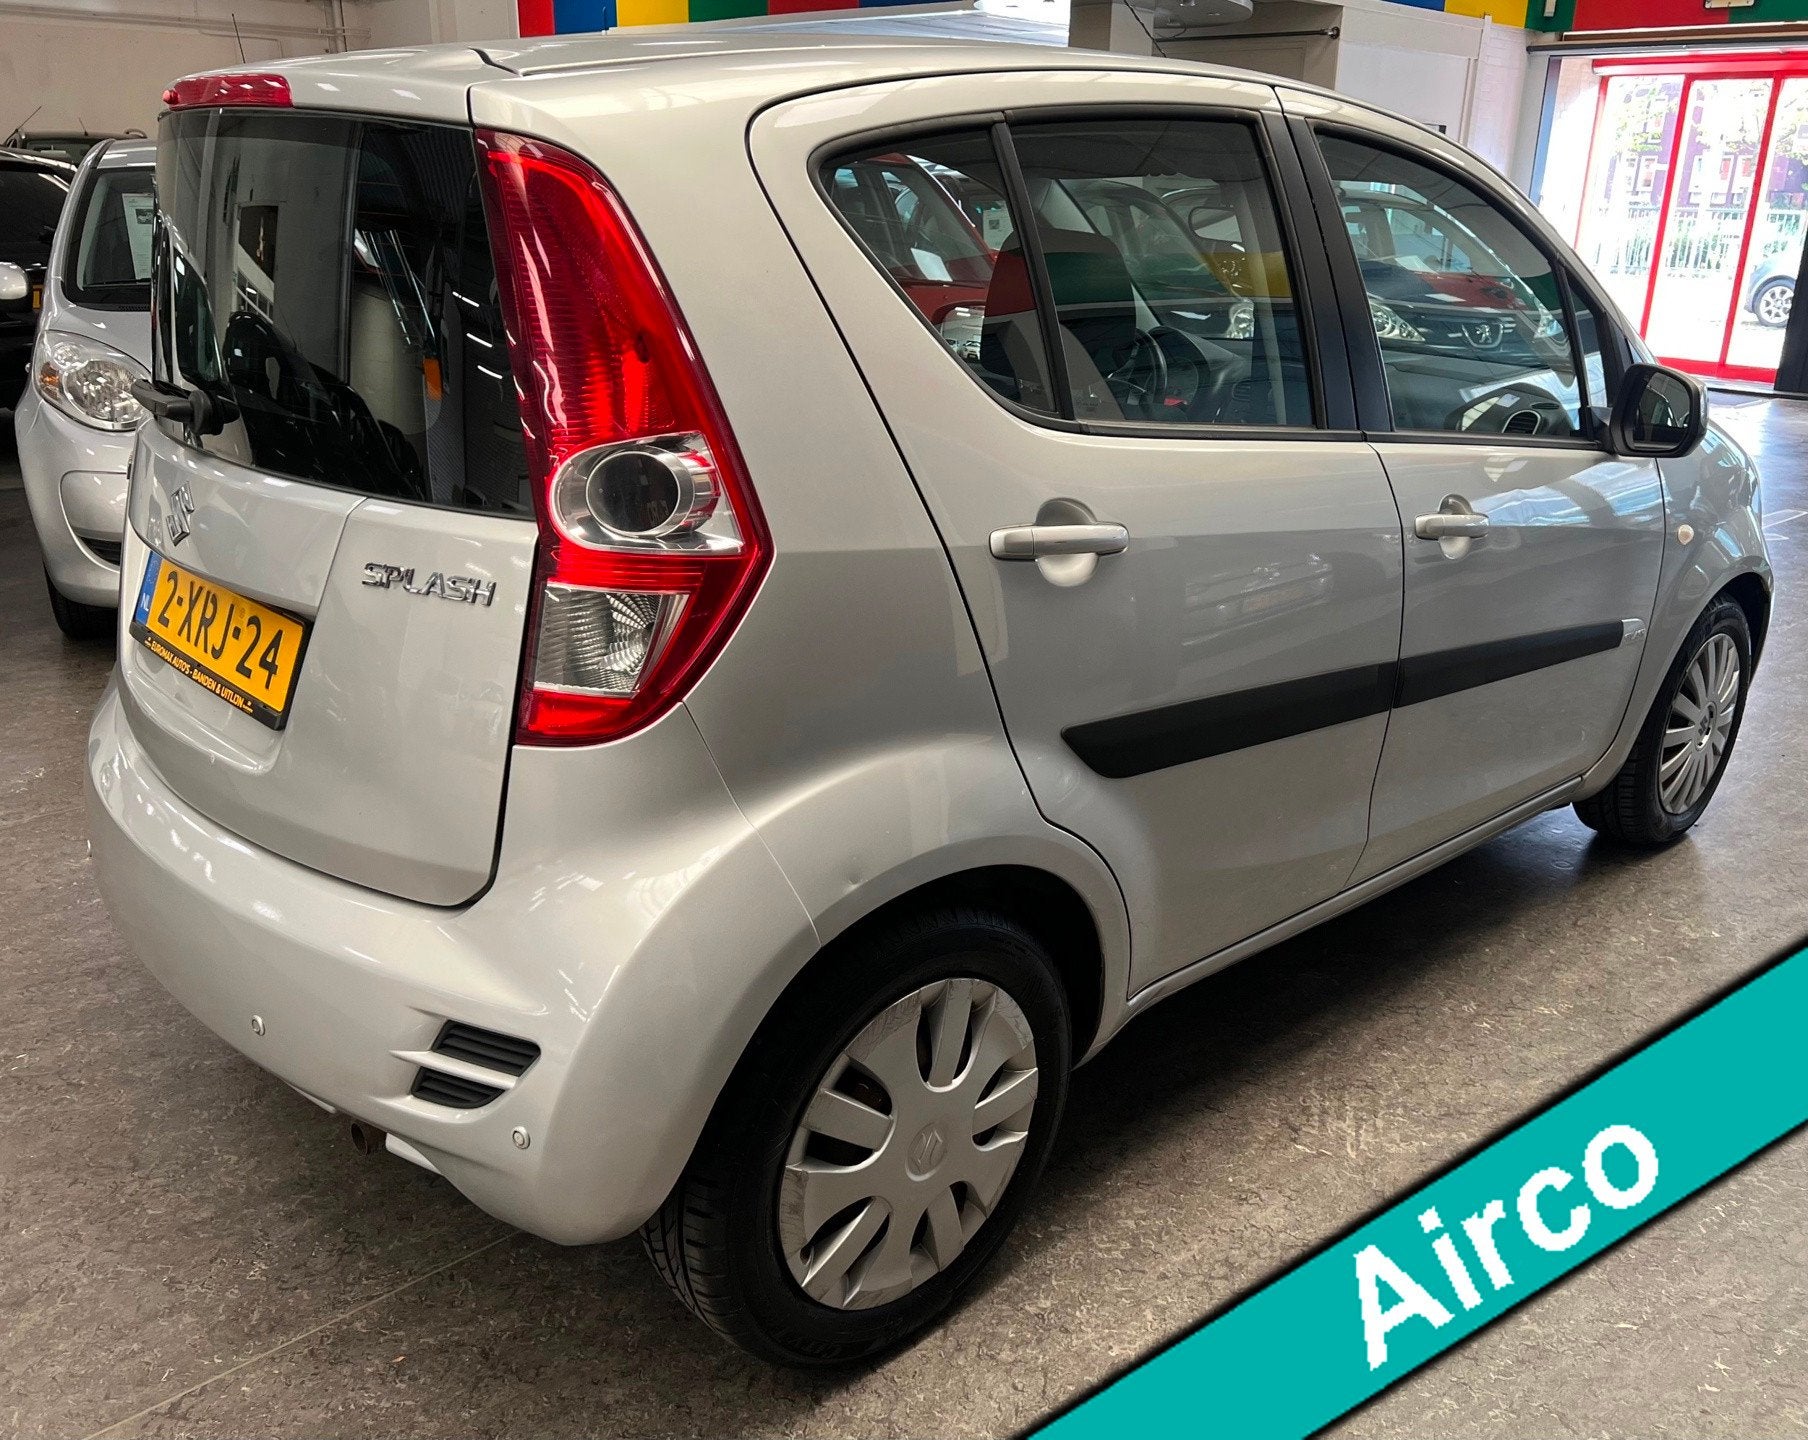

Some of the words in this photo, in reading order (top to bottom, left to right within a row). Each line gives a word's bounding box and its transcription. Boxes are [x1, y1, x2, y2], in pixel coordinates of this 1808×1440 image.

[140, 593, 150, 612] NL
[361, 562, 497, 607] SPLASH
[157, 570, 284, 690] 2-XRJ-24
[151, 641, 174, 663] EUROMAX
[192, 669, 217, 691] BANDEN
[215, 683, 221, 694] &
